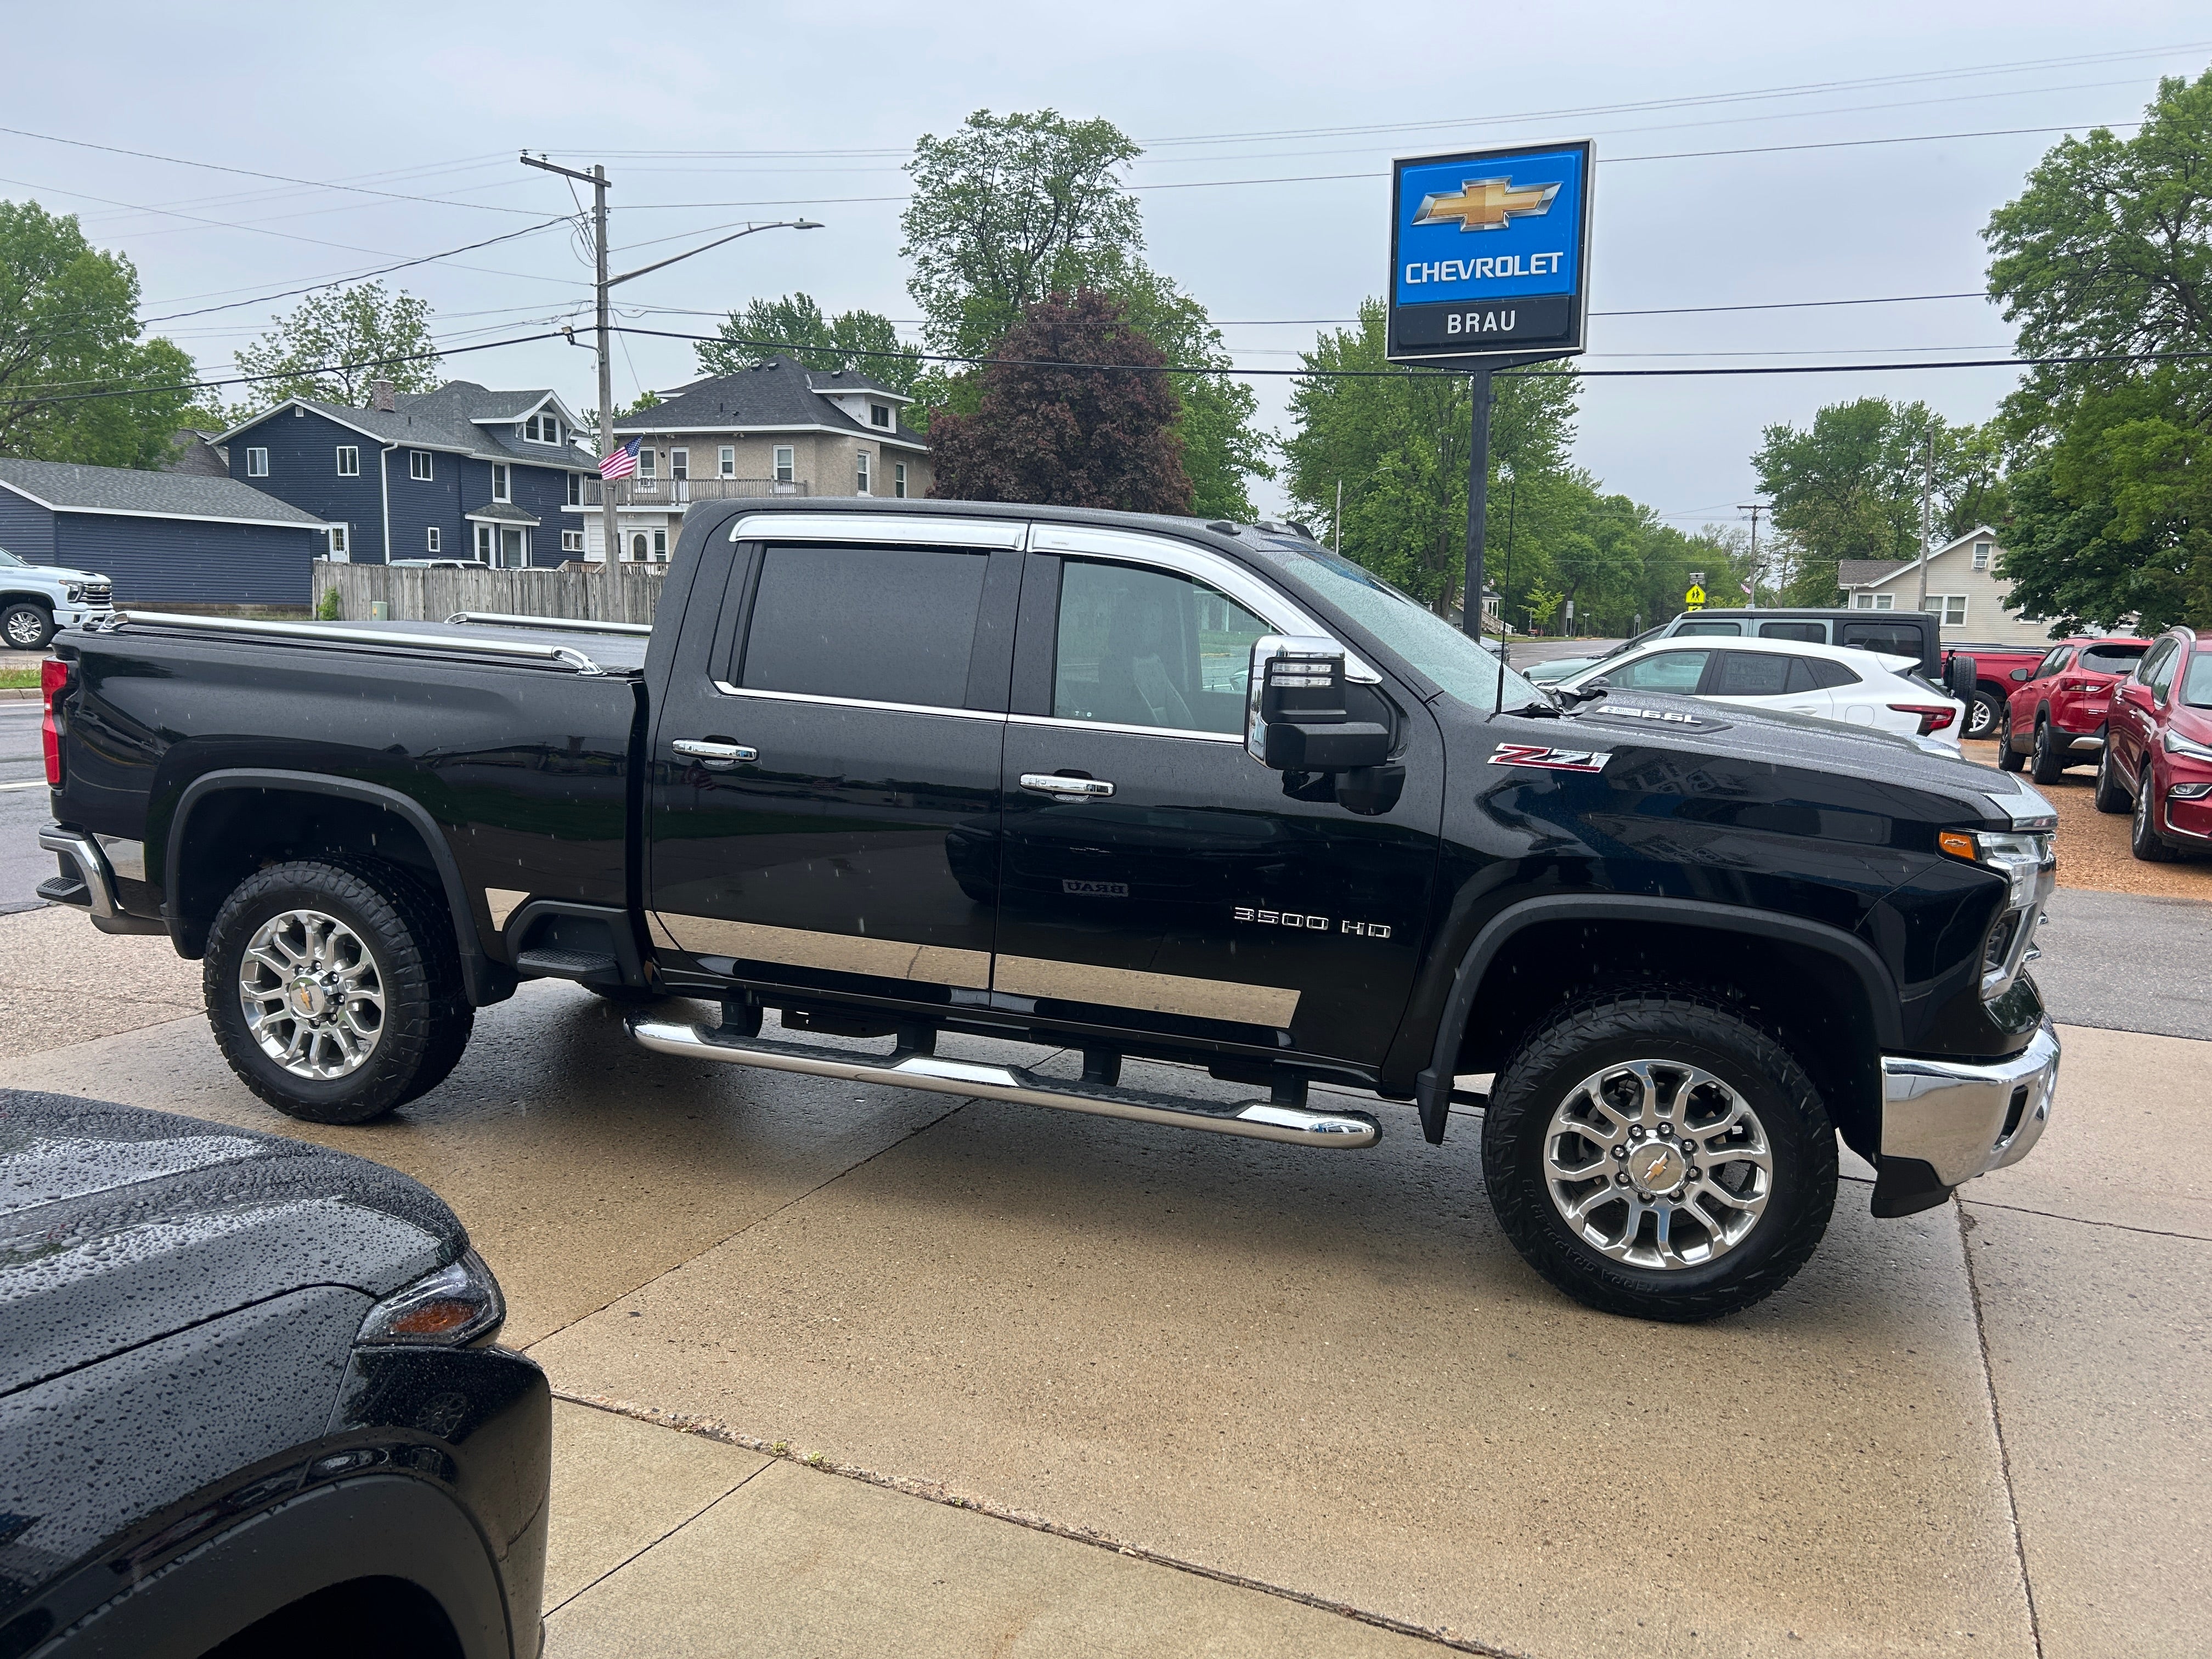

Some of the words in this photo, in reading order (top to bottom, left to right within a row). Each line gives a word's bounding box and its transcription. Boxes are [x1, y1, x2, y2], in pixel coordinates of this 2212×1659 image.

[1406, 252, 1564, 284] CHEVROLET
[1447, 310, 1516, 335] BRAU
[1642, 710, 1702, 723] 6.6L
[1487, 742, 1613, 774] Z71
[1234, 907, 1329, 930] 3500
[1341, 920, 1391, 939] HD
